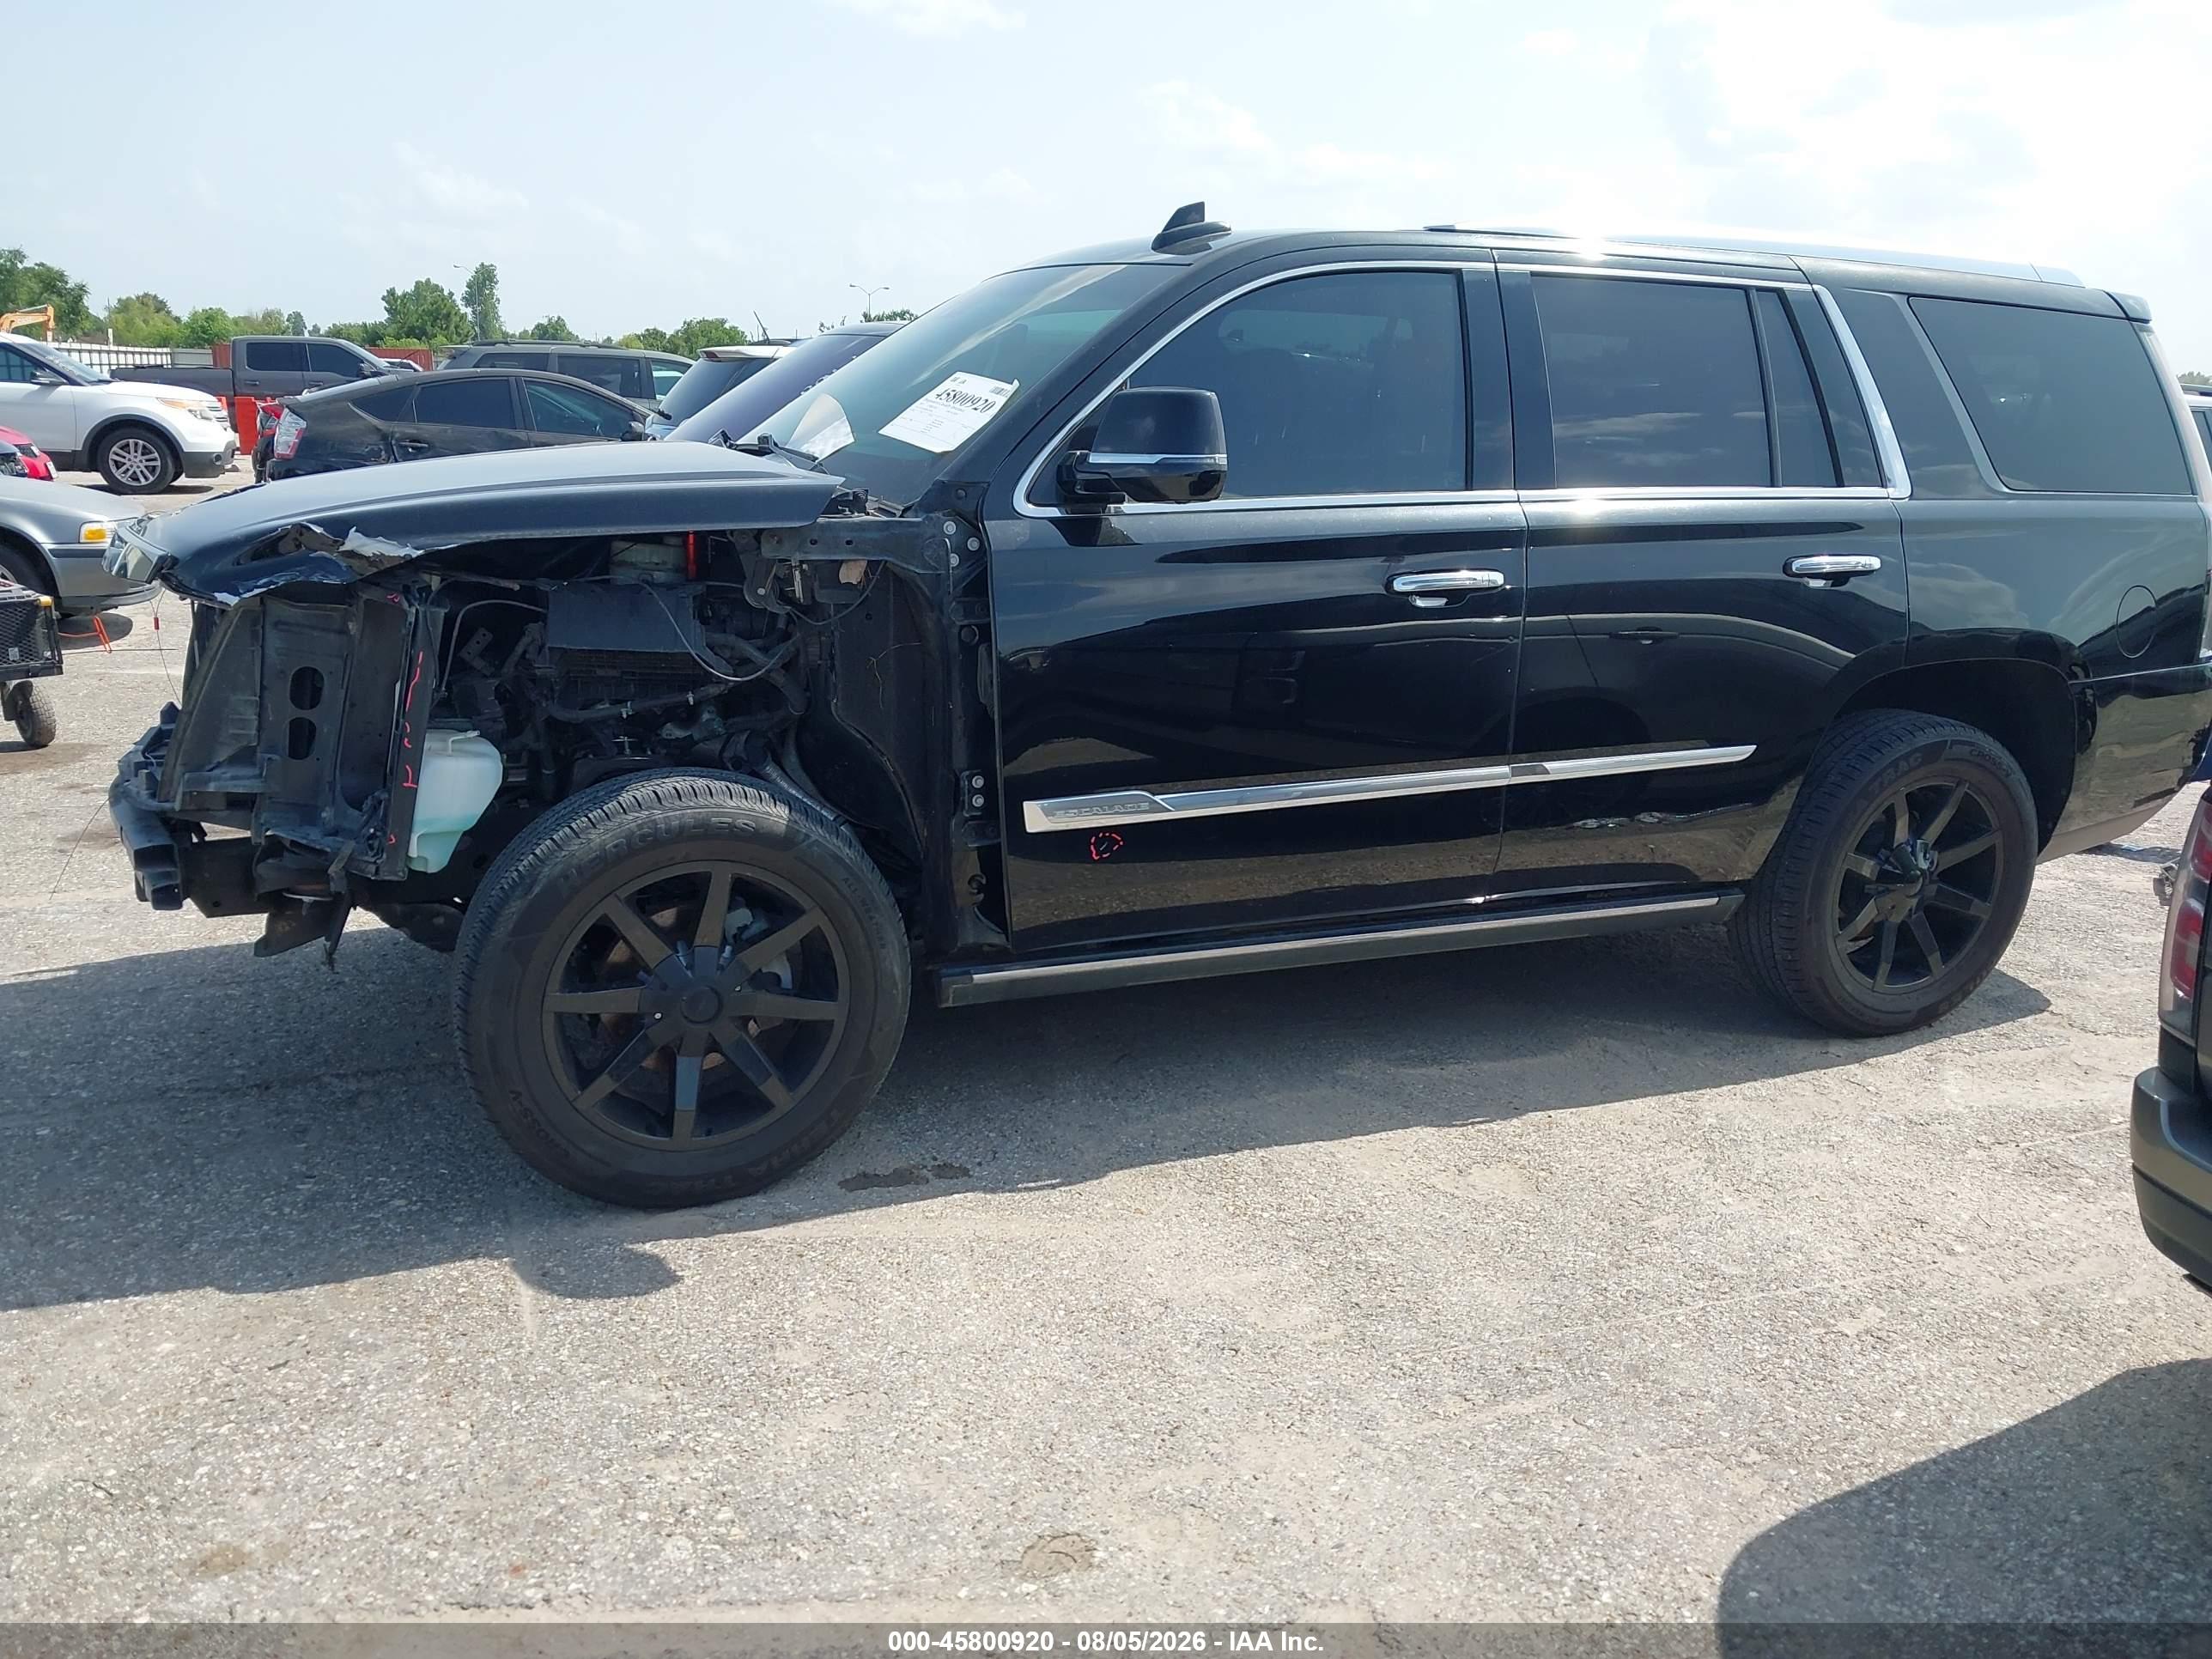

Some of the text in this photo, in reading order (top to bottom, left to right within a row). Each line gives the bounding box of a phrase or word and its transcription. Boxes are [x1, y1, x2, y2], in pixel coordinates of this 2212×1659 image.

[935, 387, 996, 414] 45800920
[1053, 802, 1150, 817] ESCALADE
[558, 816, 757, 892] HERCULES
